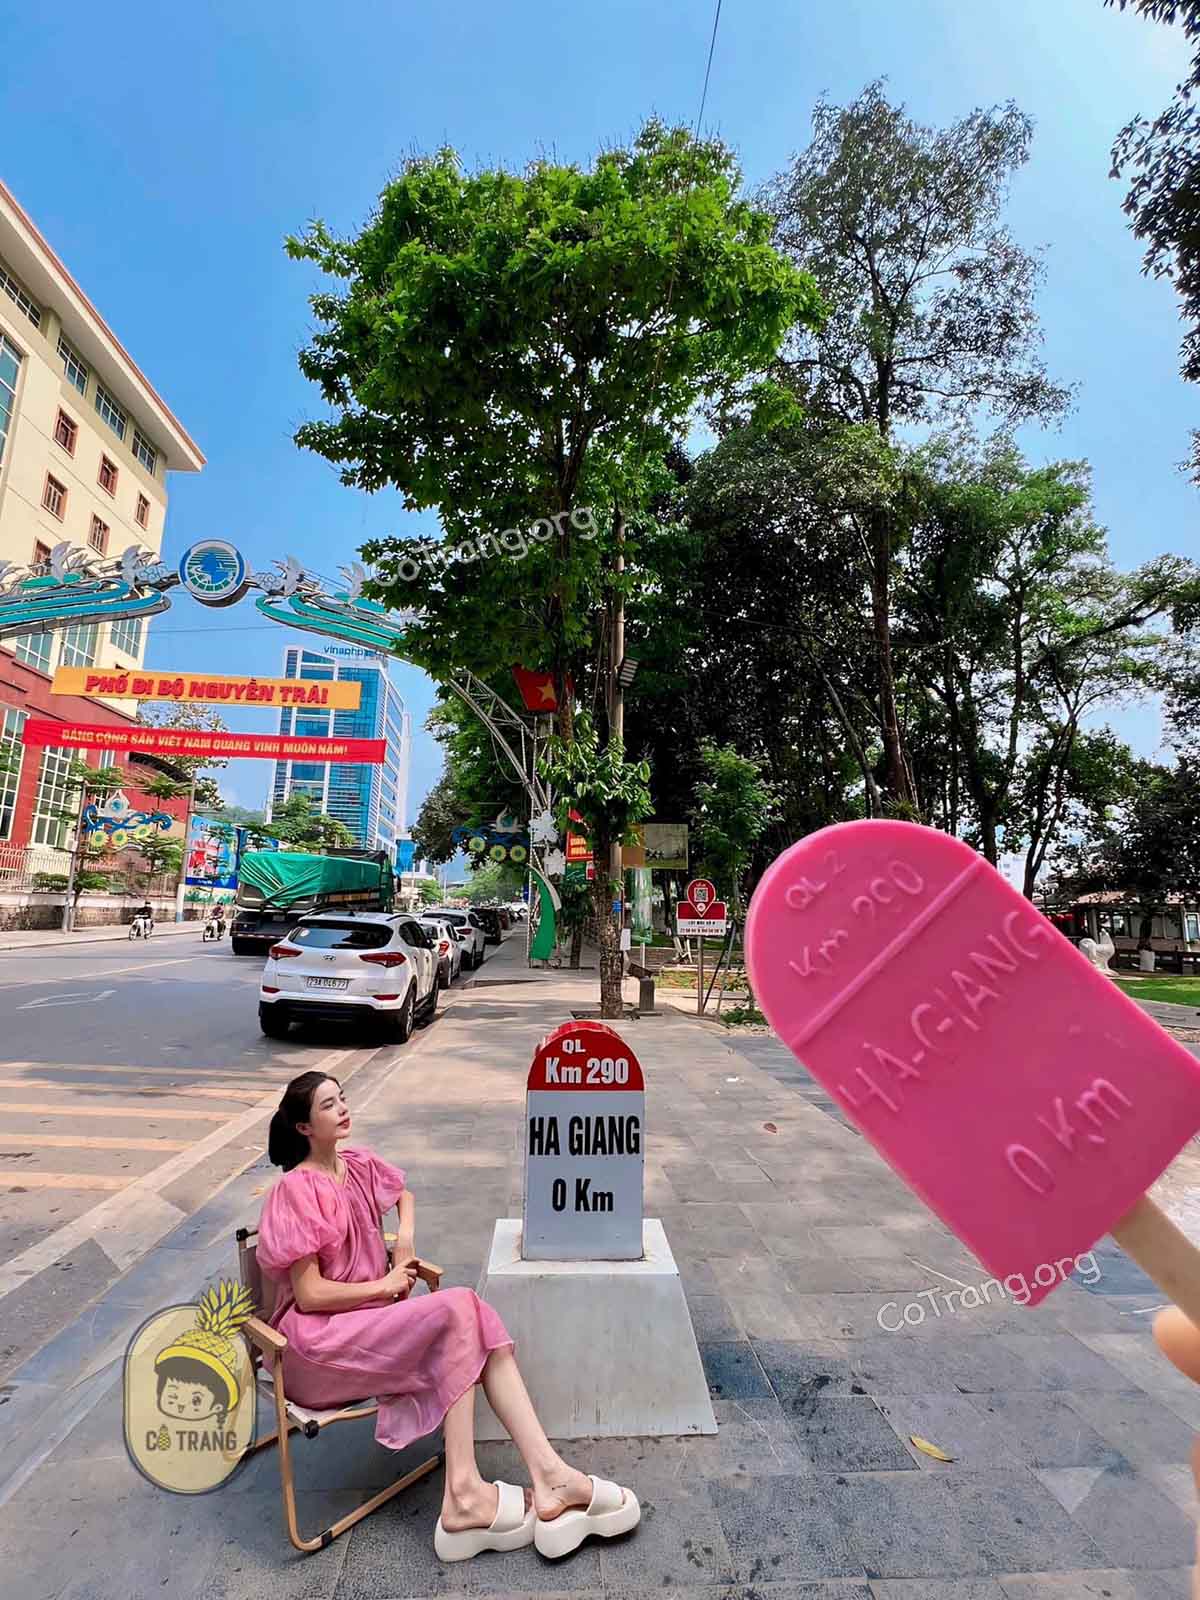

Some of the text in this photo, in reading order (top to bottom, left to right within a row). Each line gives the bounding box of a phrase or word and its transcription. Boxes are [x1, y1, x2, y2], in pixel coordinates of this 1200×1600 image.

[85, 671, 130, 693] PHỐ
[158, 677, 184, 699] BỘ
[184, 738, 211, 749] NAM
[213, 739, 251, 751] QUANG
[254, 742, 280, 753] VINH
[561, 1038, 587, 1054] QL
[545, 1057, 629, 1085] Km 290
[529, 1115, 641, 1156] HA GIANG
[551, 1177, 614, 1213] 0 Km
